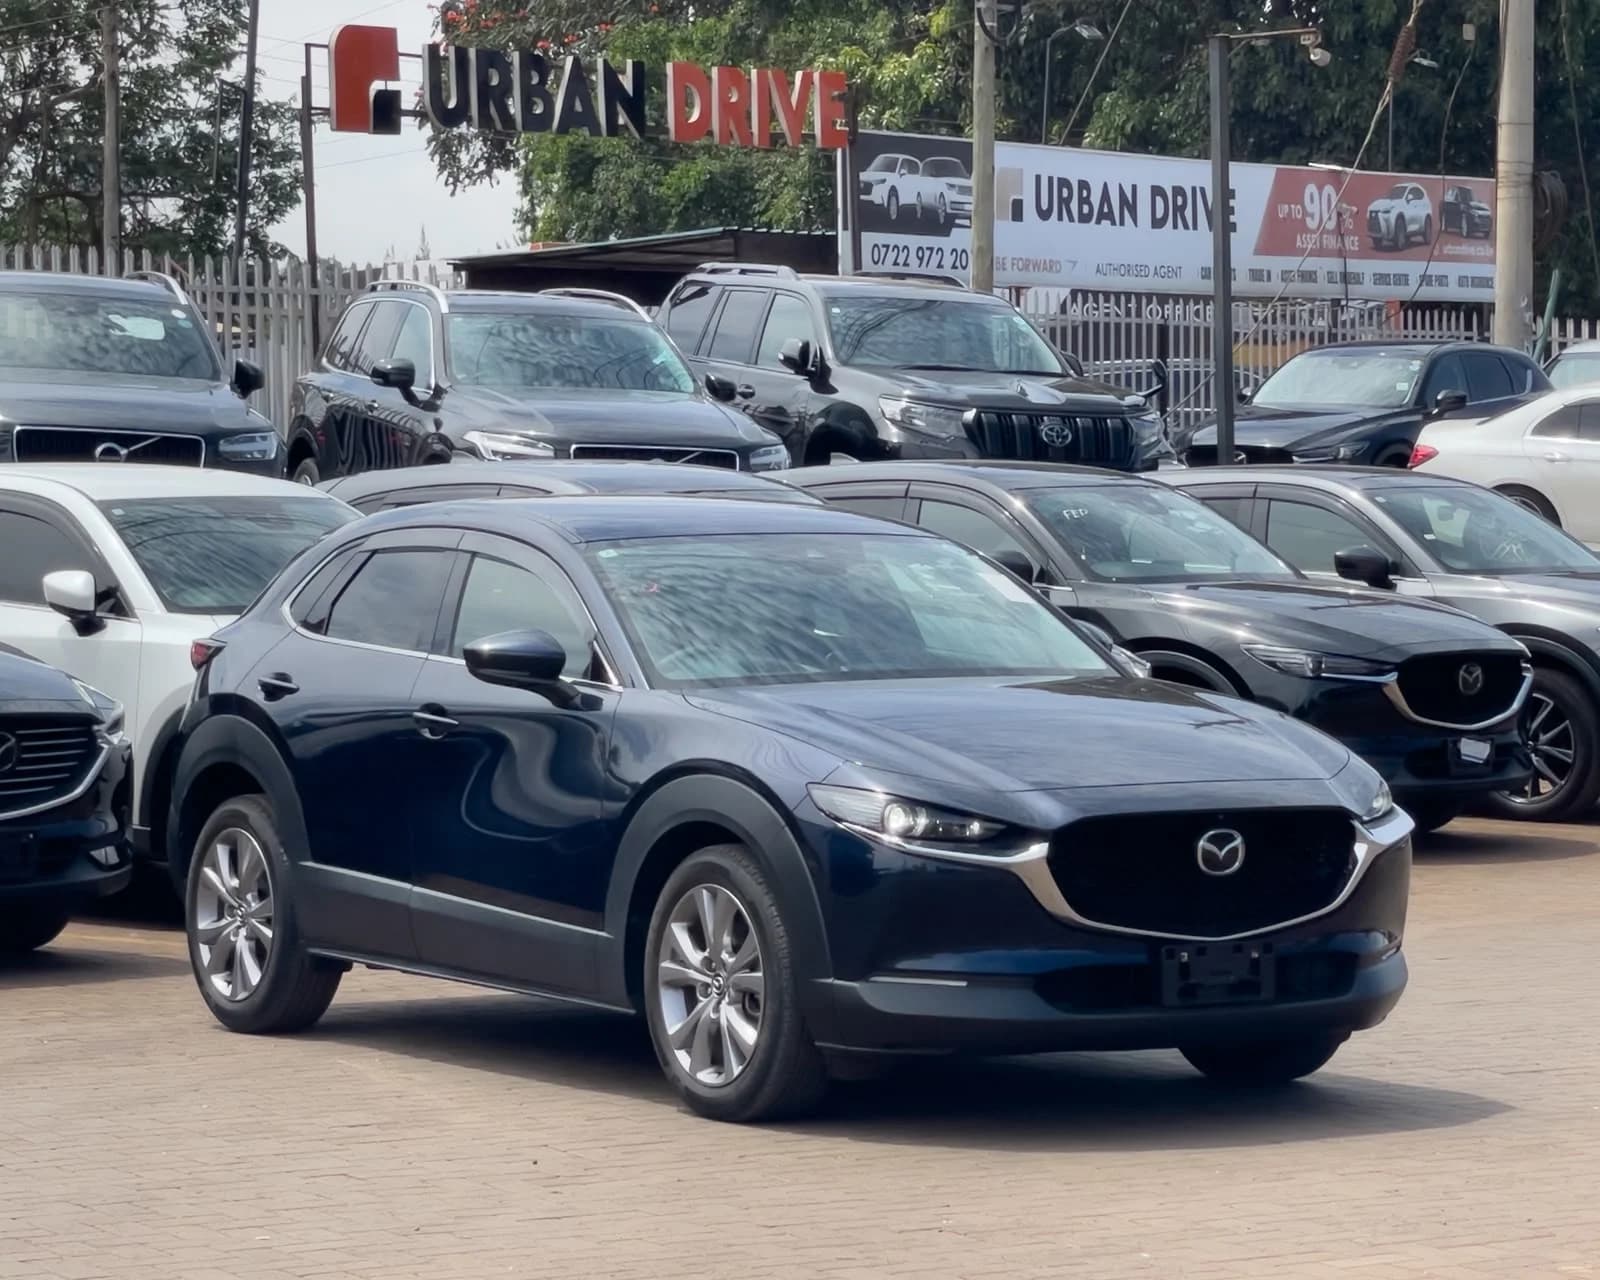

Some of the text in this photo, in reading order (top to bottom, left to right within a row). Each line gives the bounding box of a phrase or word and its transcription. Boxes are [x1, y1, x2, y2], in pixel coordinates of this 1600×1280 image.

[422, 43, 848, 149] URBAN DRIVE
[1034, 174, 1139, 228] URBAN
[1278, 204, 1288, 218] UP
[1291, 205, 1302, 219] TO
[871, 243, 969, 271] 0722 972 20
[996, 256, 1062, 273] BE FORWARD
[1095, 263, 1183, 279] AUTHORISED AGENT
